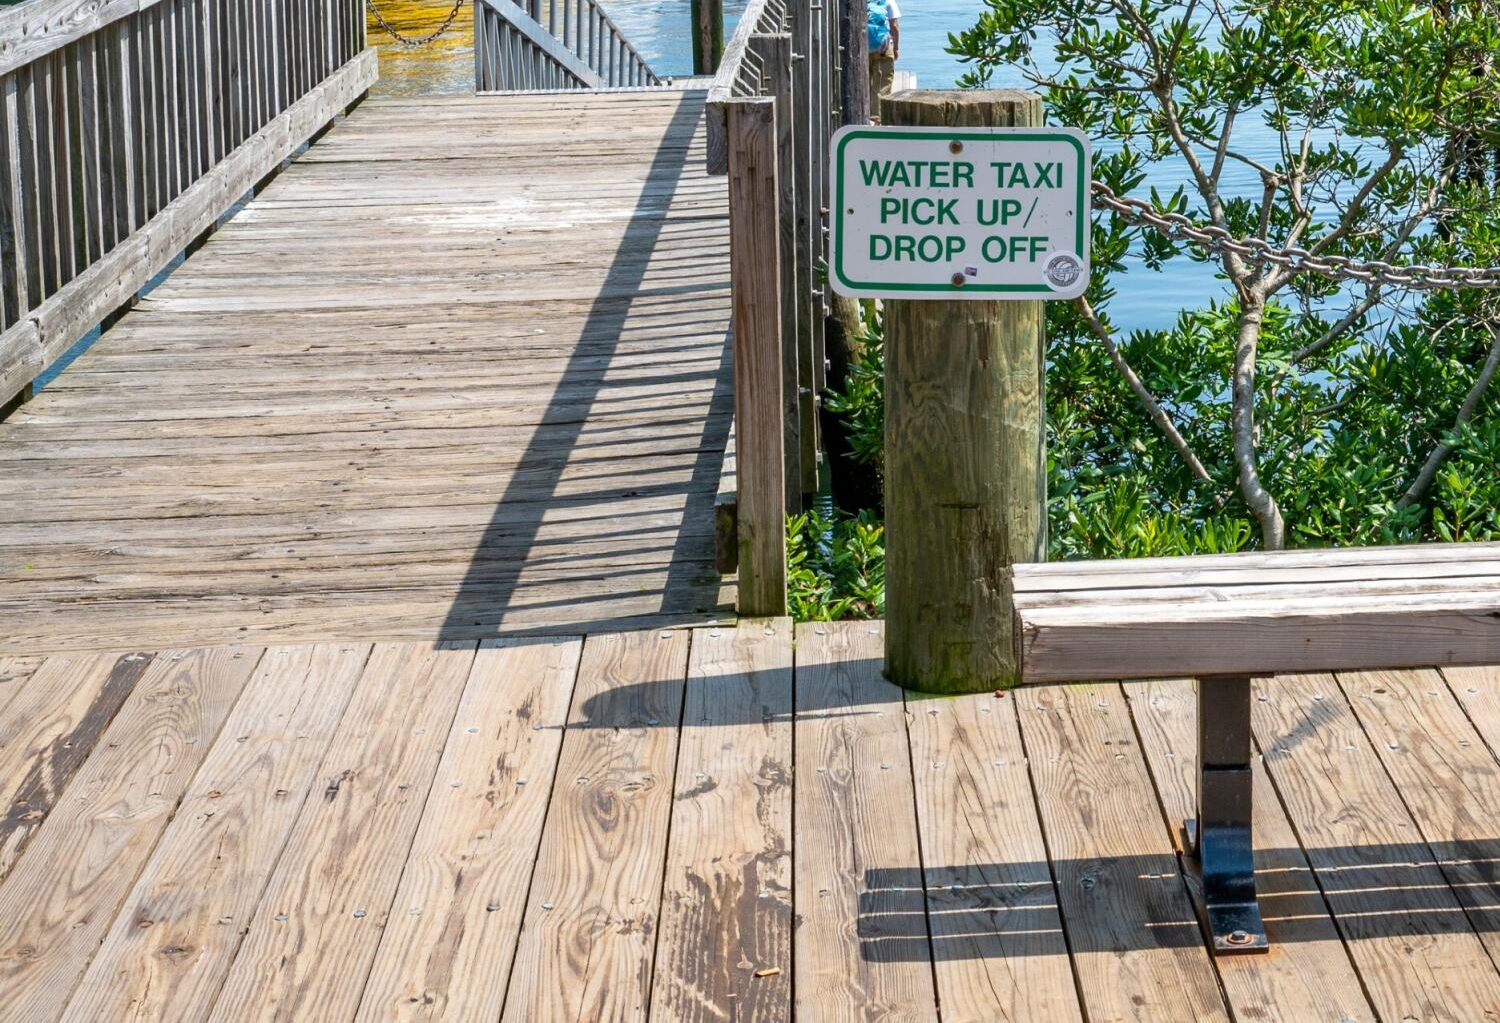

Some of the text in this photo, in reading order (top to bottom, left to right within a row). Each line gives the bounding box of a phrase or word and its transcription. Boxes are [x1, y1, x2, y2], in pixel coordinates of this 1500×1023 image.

[859, 160, 1063, 189] WATER TAXI
[880, 196, 1039, 229] PICK UP/
[869, 234, 1049, 263] DROP OFF
